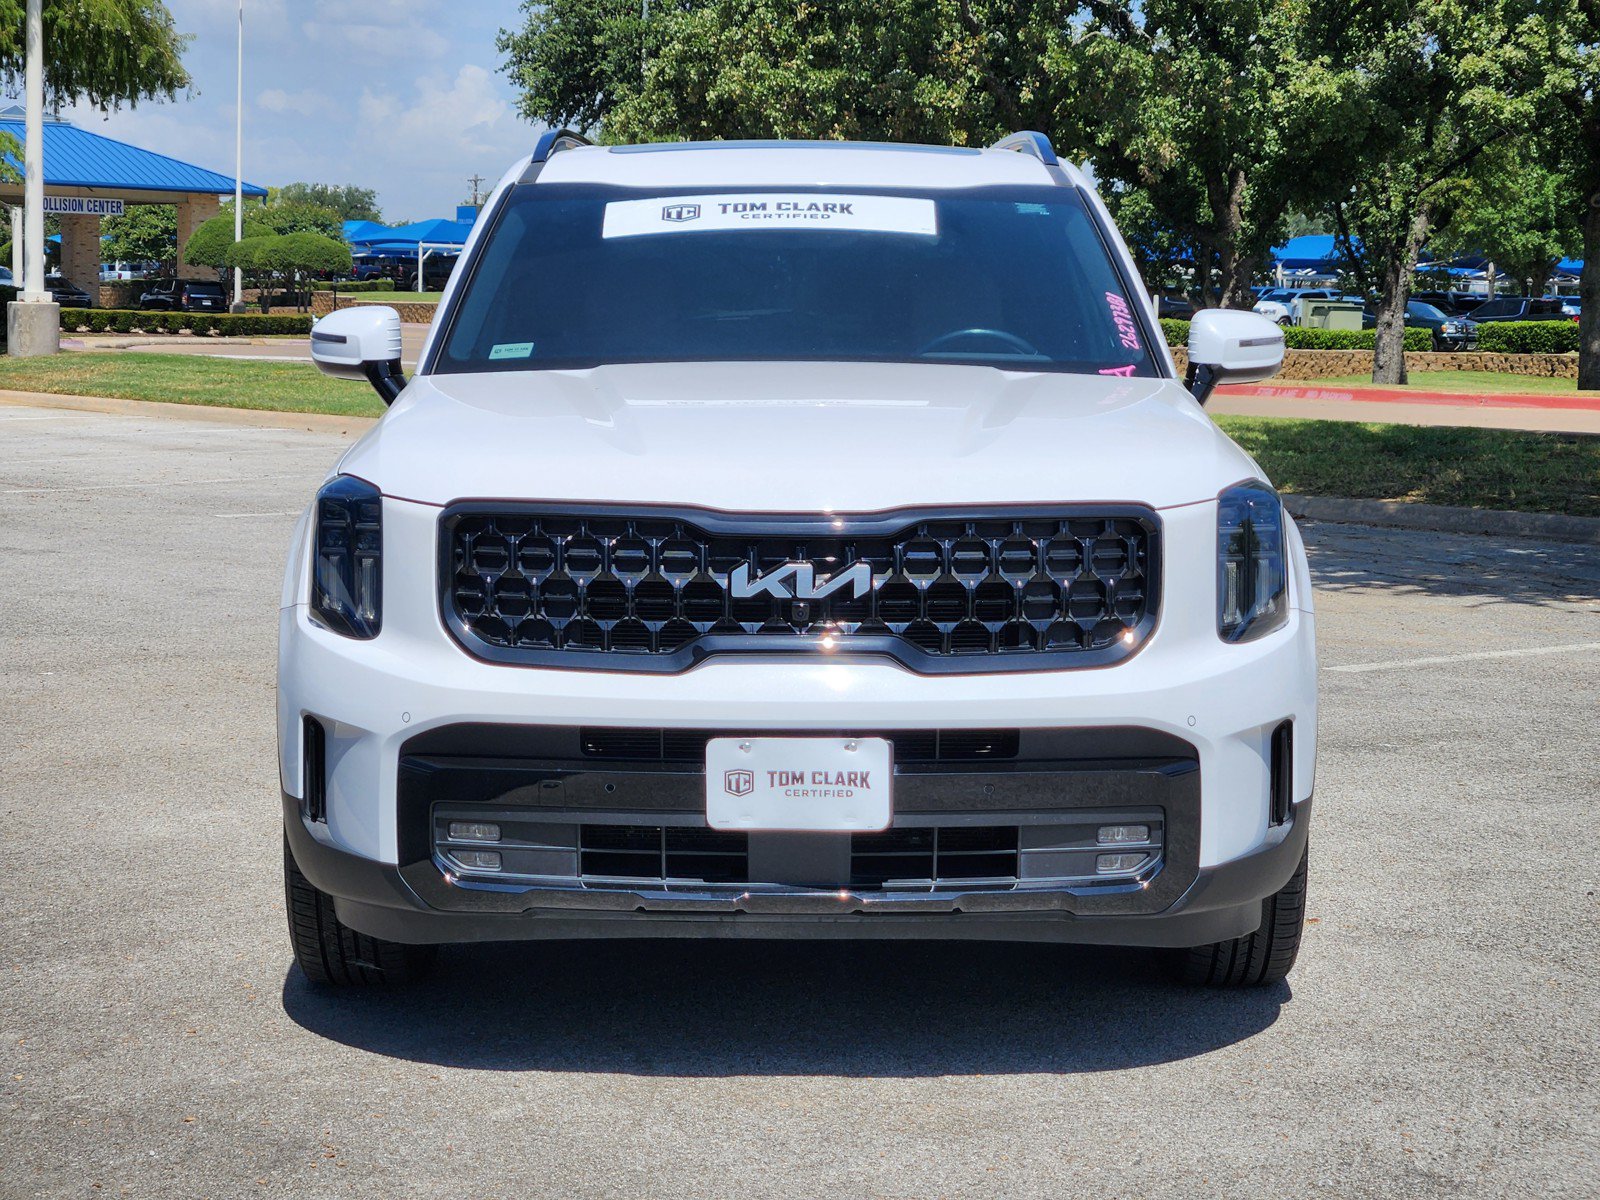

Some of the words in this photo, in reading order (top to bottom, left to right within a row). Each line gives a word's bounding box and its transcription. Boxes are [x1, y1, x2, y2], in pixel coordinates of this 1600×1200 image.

[43, 197, 83, 211] OLLISION
[86, 200, 122, 213] CENTER
[718, 202, 767, 214] TOM
[776, 202, 854, 215] CLARK
[730, 562, 872, 599] KIA
[767, 770, 805, 788] TOM
[811, 770, 871, 789] CLARK
[784, 788, 854, 798] CERTIFIED
